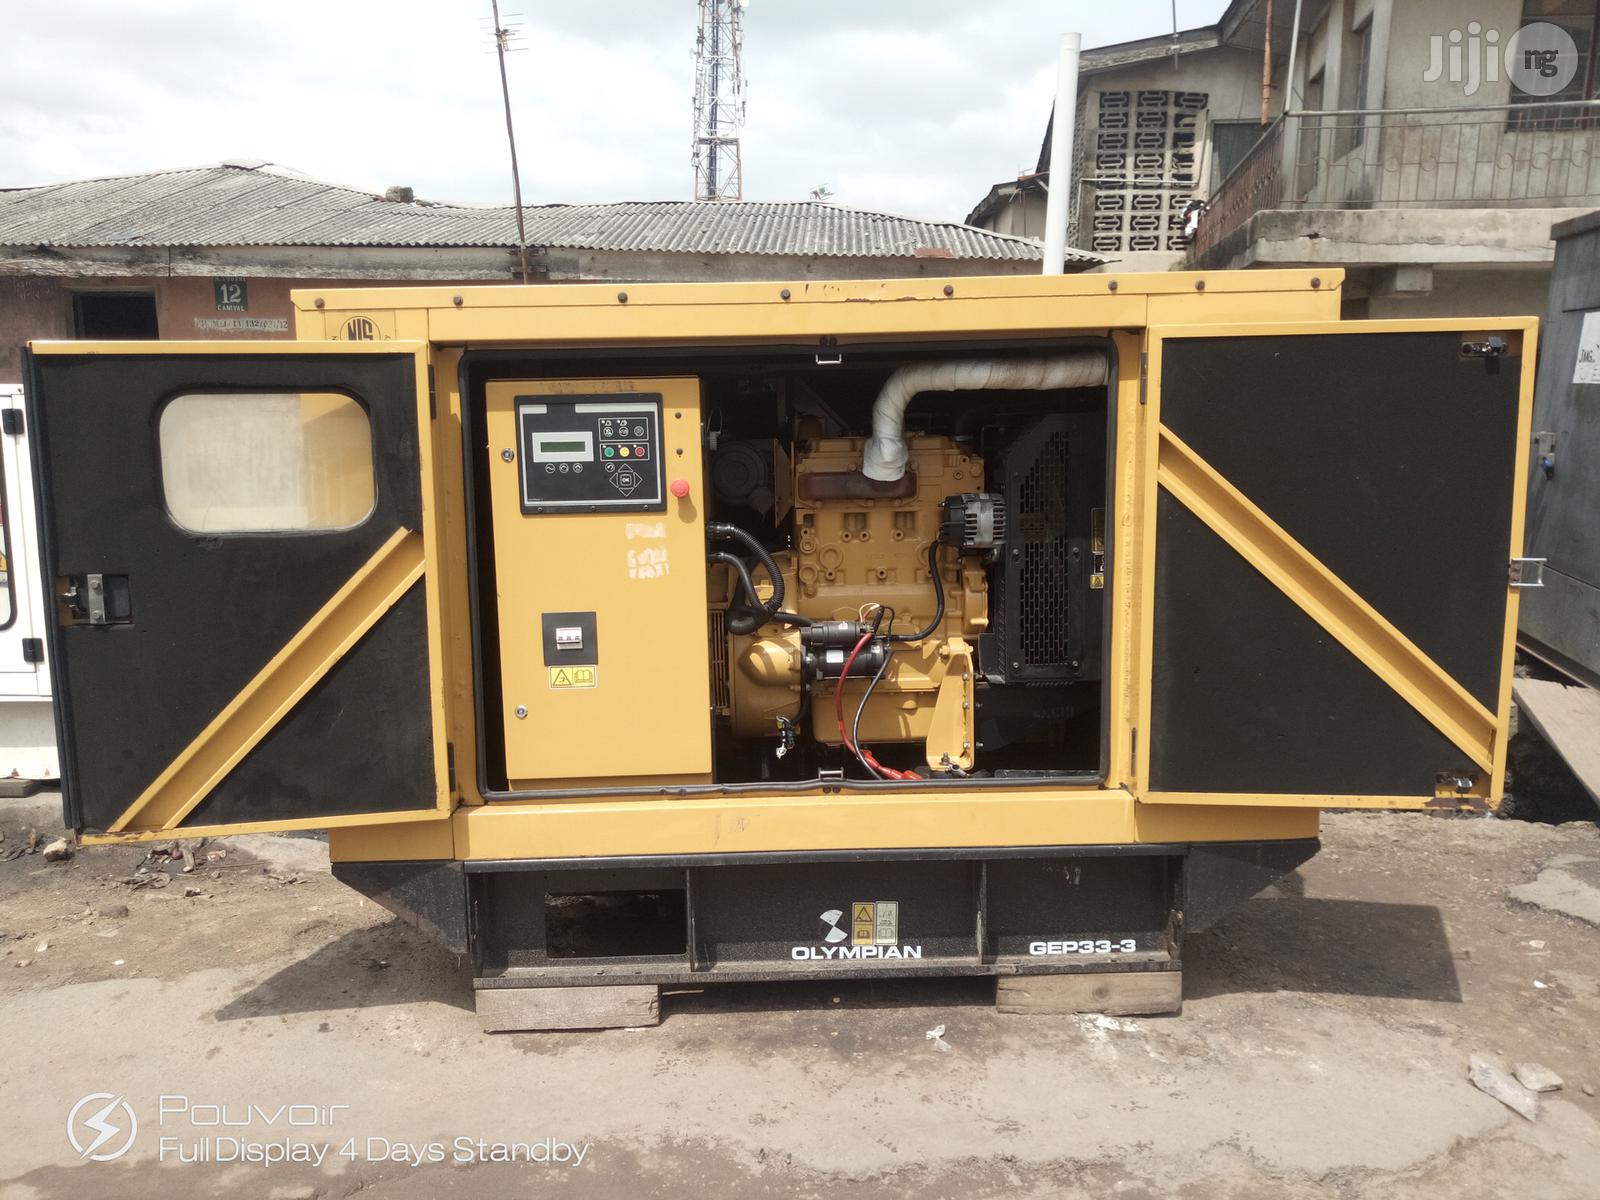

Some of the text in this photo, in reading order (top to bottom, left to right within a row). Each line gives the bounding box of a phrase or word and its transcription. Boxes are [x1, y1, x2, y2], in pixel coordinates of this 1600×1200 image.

[220, 284, 241, 304] 12
[791, 945, 922, 960] OLYMPIAN
[1030, 939, 1137, 955] GEP33-3
